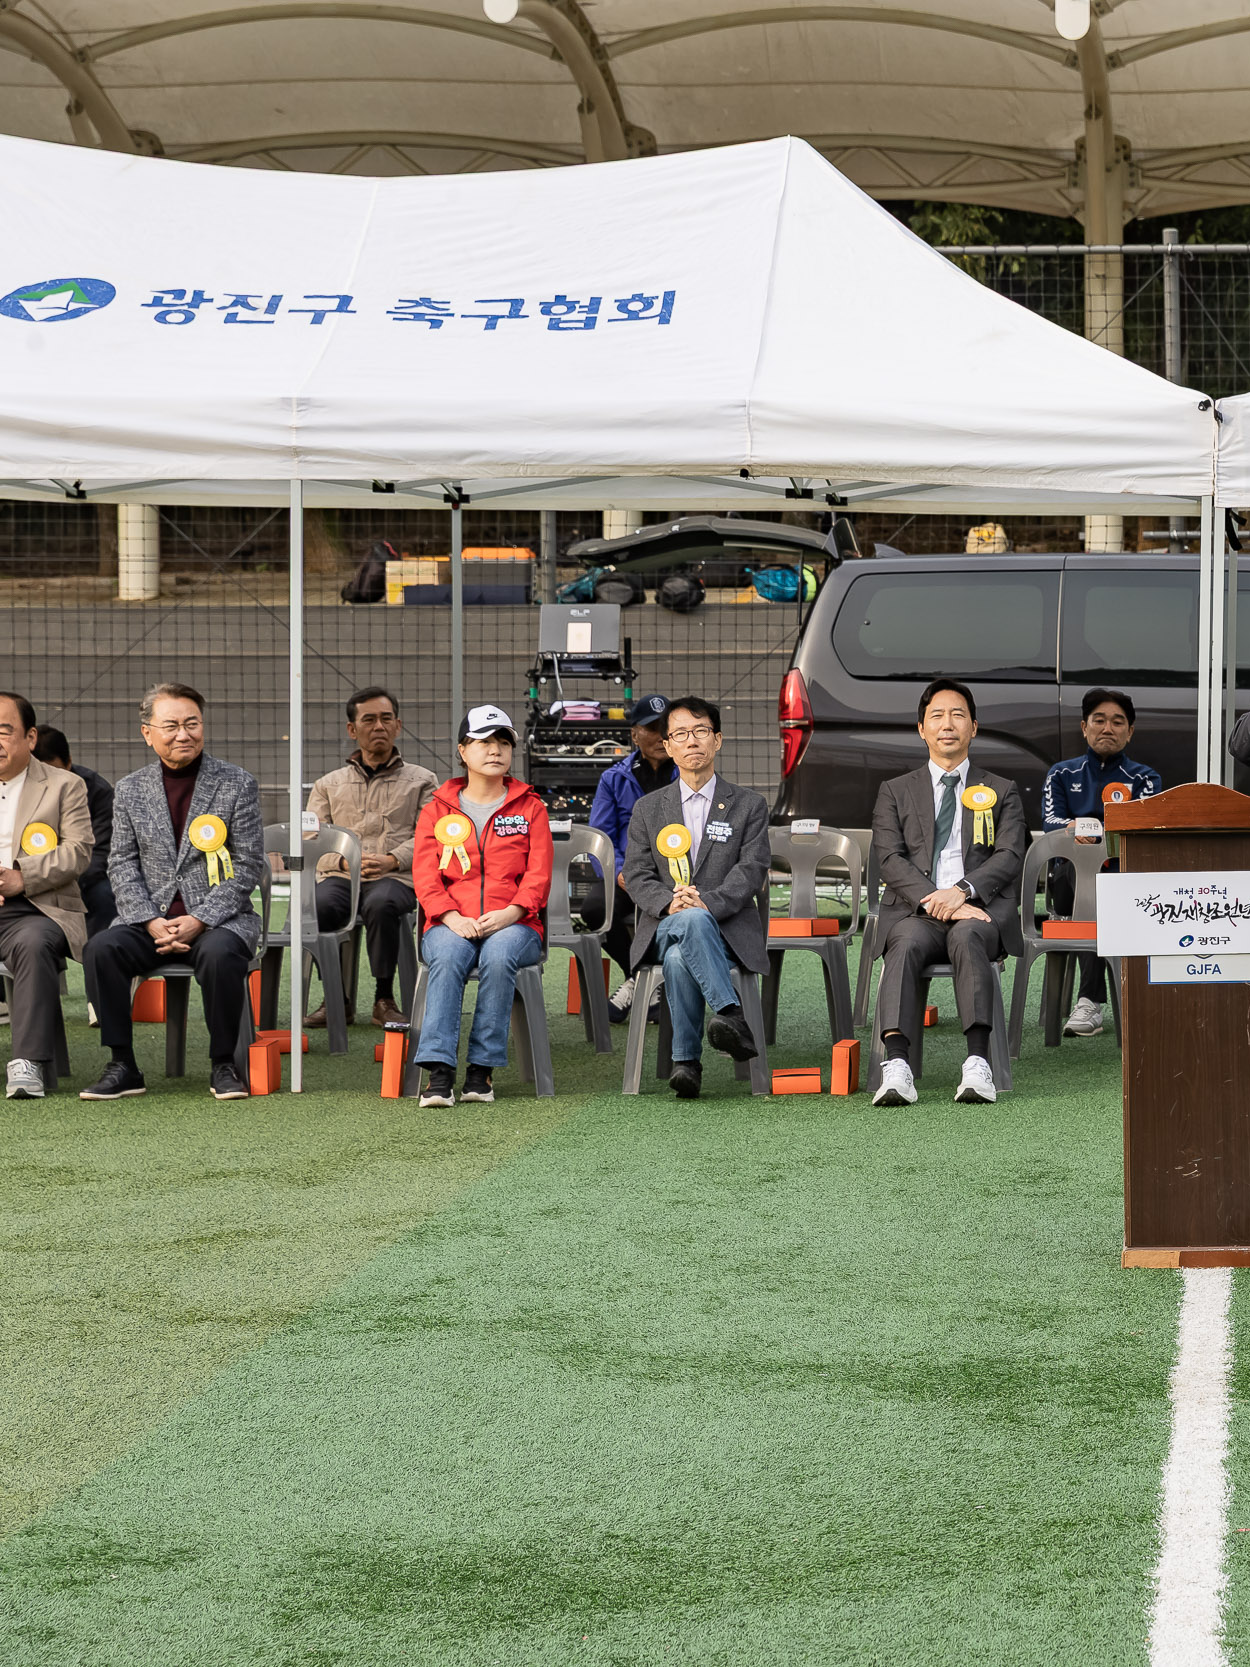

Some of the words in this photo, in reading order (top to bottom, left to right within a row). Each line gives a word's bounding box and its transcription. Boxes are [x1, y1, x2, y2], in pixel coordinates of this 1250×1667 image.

[142, 288, 357, 325] 광진구
[386, 290, 676, 331] 축구협회
[1173, 887, 1194, 900] 개청
[1198, 885, 1228, 900] 30주년
[1197, 936, 1231, 946] 광진구
[1186, 963, 1222, 976] GJFA
